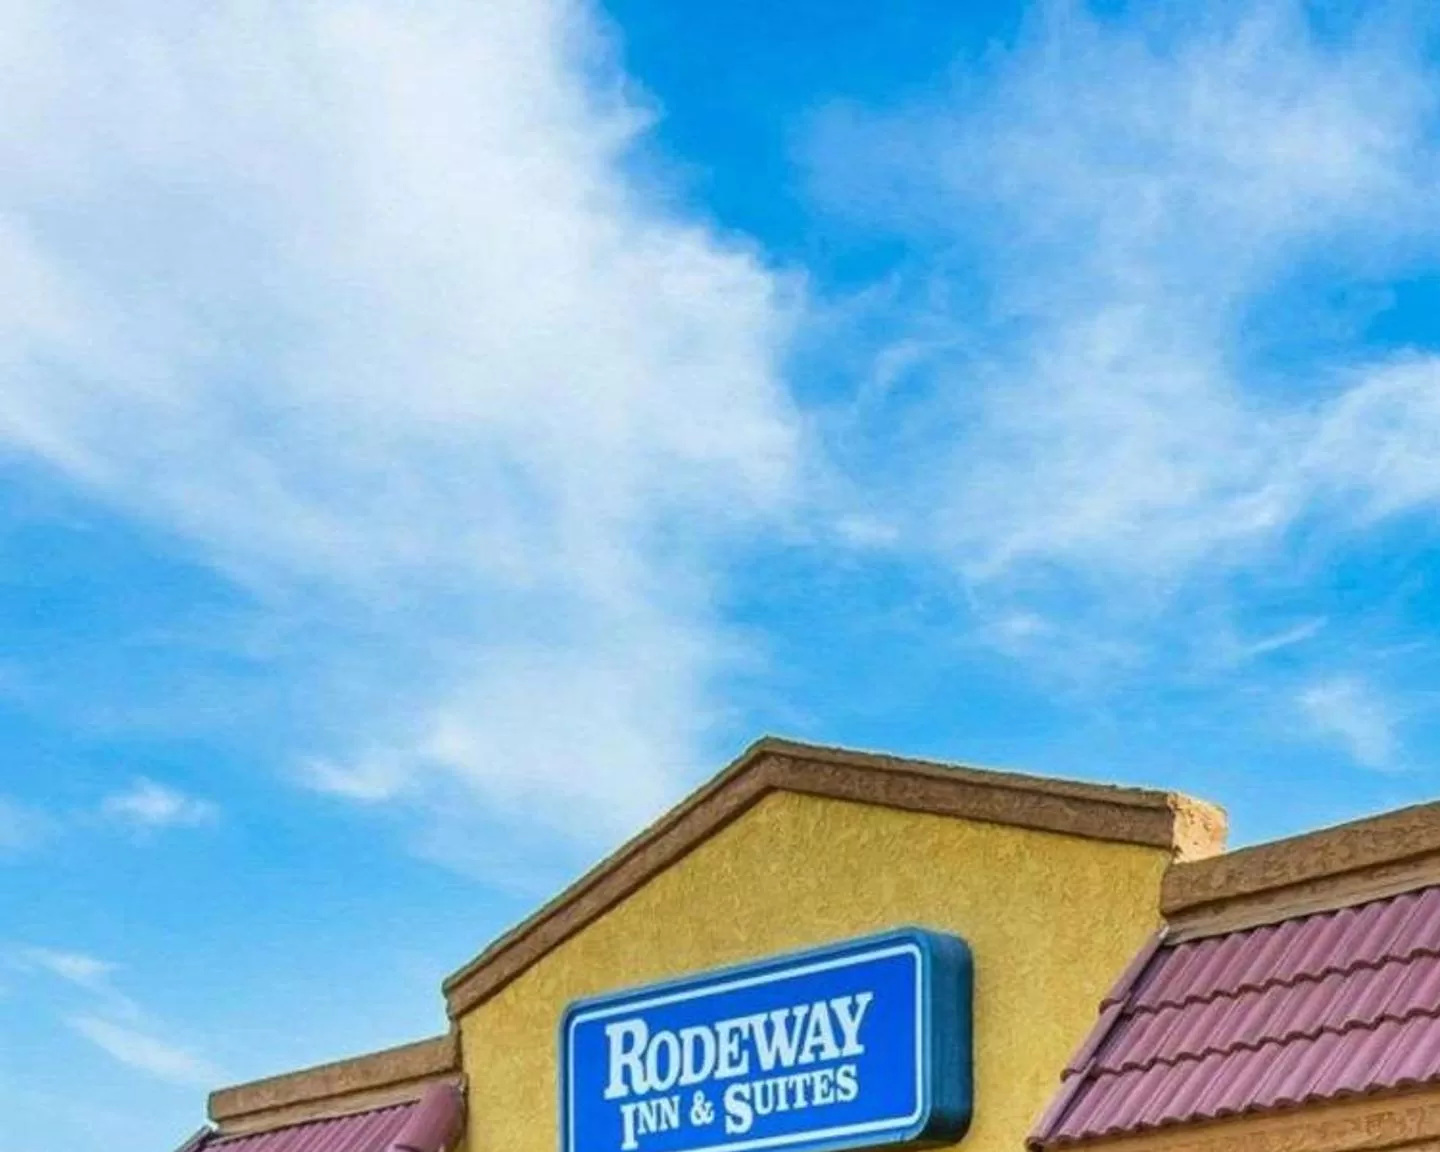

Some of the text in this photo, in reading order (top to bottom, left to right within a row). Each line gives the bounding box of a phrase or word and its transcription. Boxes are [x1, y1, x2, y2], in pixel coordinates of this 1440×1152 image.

[604, 991, 874, 1099] RODEWAY
[620, 1064, 859, 1151] INN & SUITES
